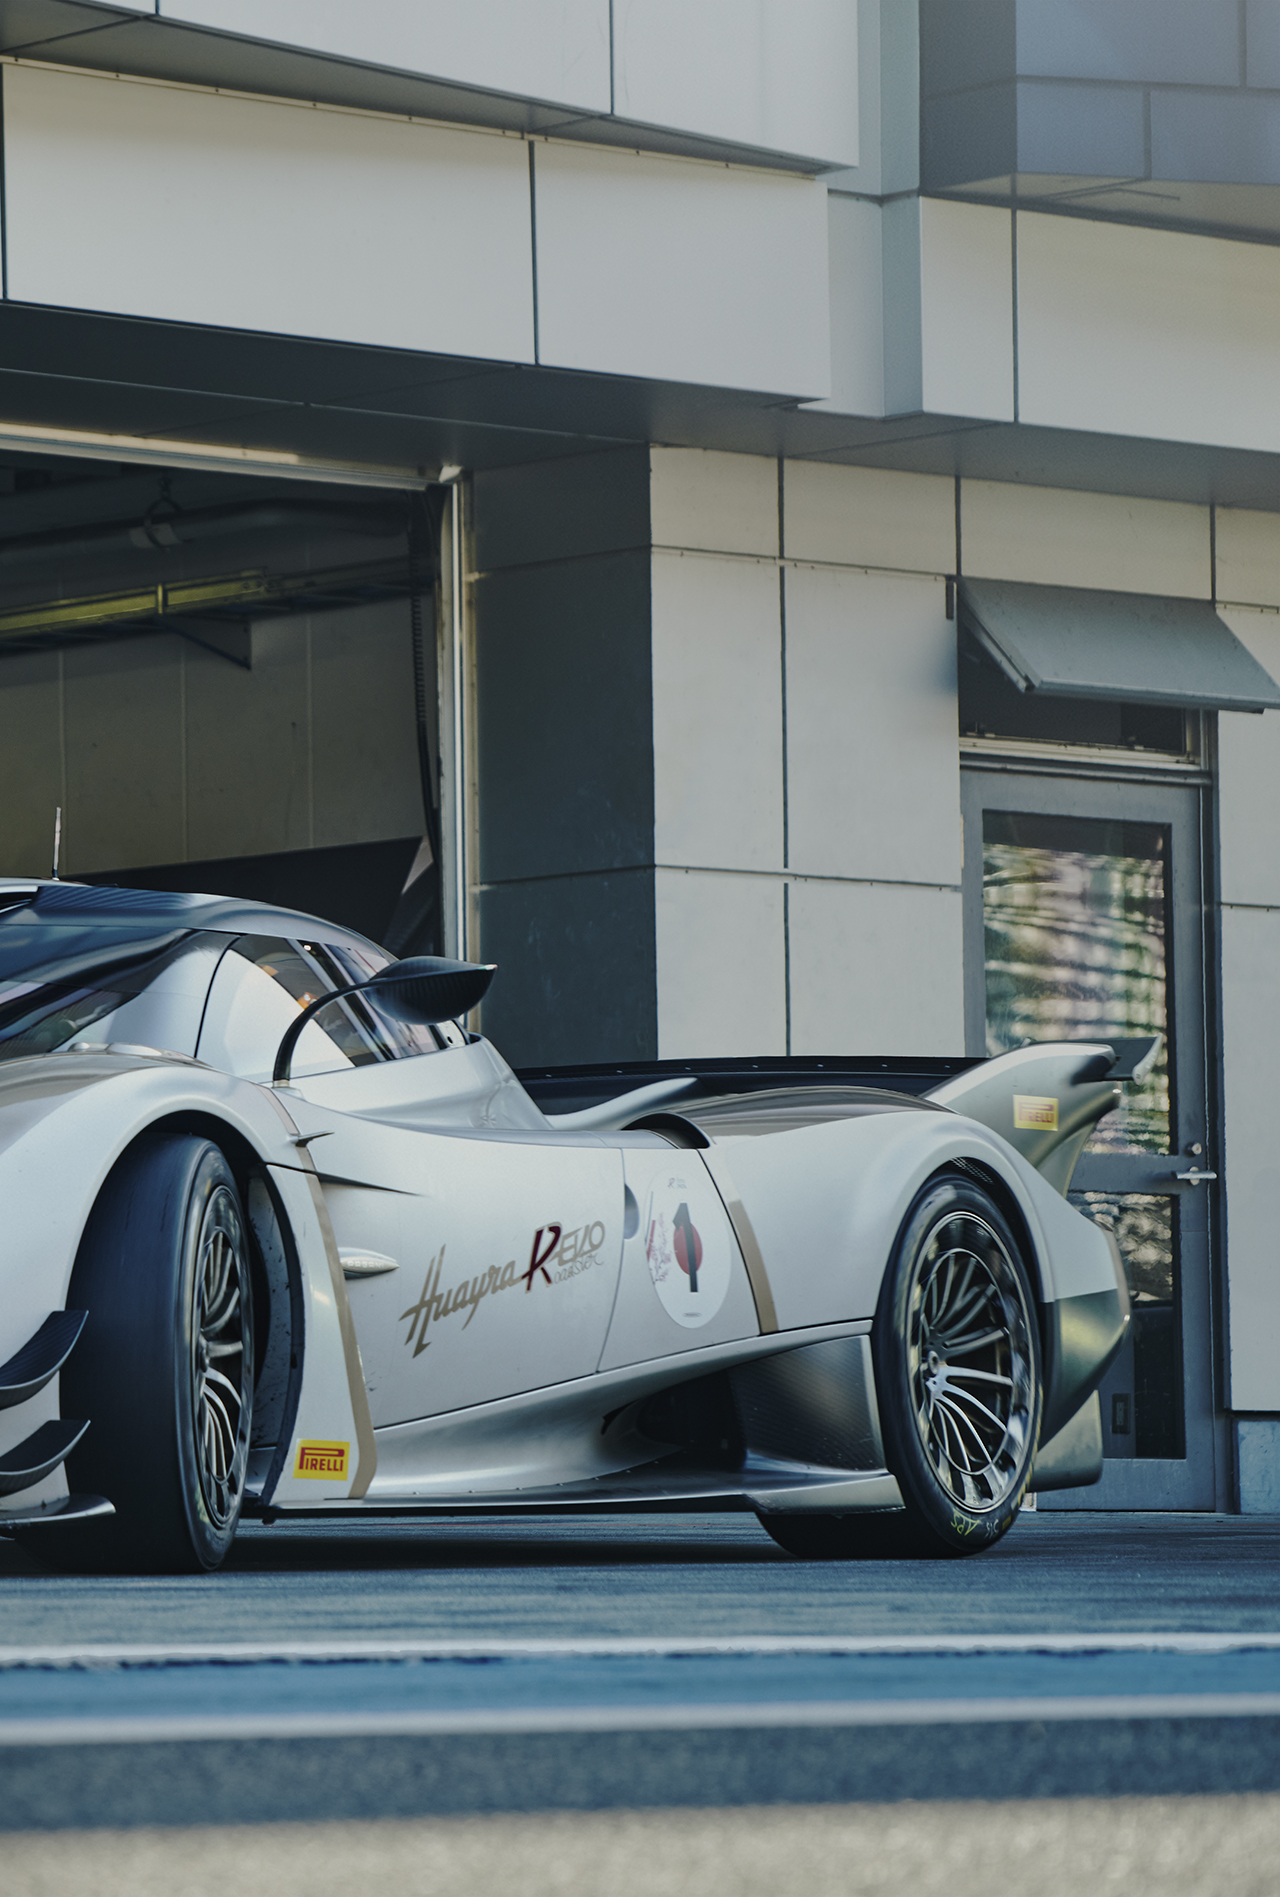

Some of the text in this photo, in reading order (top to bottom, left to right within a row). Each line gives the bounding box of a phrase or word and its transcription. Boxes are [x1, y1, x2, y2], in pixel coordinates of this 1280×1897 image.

[672, 1202, 699, 1293] 1
[398, 1243, 523, 1359] Huayra
[299, 1446, 345, 1472] PIRELLI
